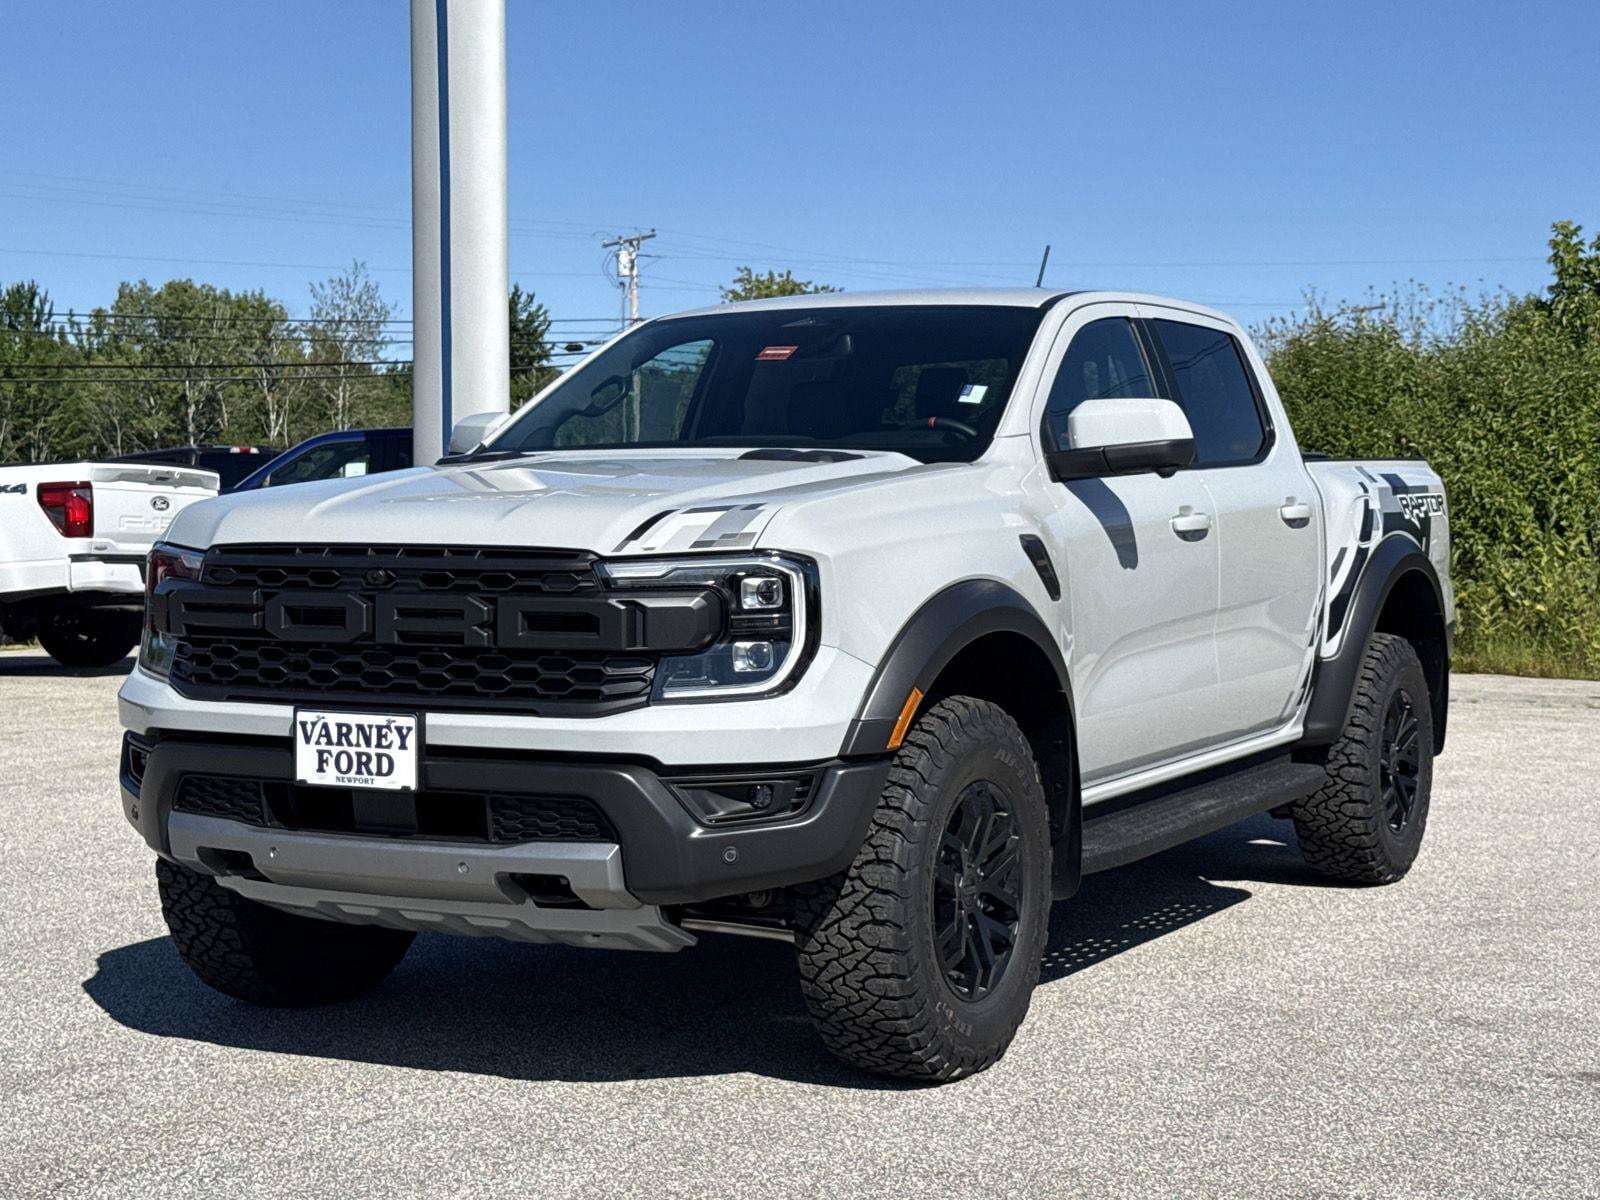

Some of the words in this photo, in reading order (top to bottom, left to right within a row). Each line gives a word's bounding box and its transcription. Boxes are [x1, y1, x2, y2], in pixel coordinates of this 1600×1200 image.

[1397, 493, 1446, 527] RAPTOR
[168, 588, 633, 650] FORD
[298, 720, 413, 750] VARNEY
[315, 749, 395, 777] FORD
[335, 776, 375, 785] NEWPORT
